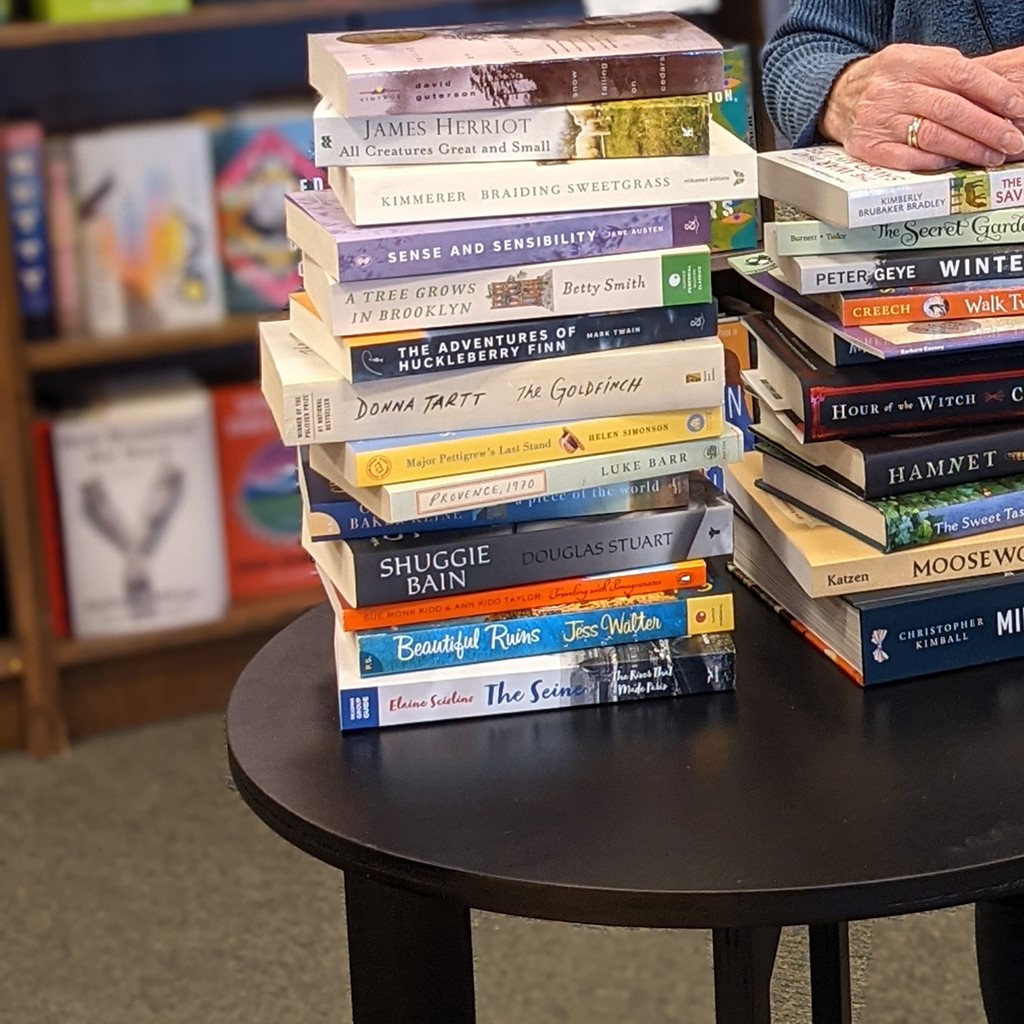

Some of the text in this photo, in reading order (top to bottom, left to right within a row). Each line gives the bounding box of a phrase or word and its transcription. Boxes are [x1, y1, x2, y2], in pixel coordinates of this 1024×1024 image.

[415, 79, 452, 90] david
[571, 69, 579, 98] snow
[601, 62, 609, 97] falling
[630, 79, 638, 95] on
[659, 56, 667, 93] cedars
[416, 91, 477, 103] guterson
[363, 116, 533, 141] JAMES HERRIOT
[339, 139, 551, 158] All Creatures Great and Small
[381, 176, 671, 207] KIMMERER BRAIDING SWEETGRASS
[1001, 177, 1023, 190] THE
[858, 198, 947, 218] BRUBAKER BRADLEY
[880, 191, 924, 207] KIMBERLY
[631, 225, 665, 236] AUSTEN
[826, 232, 847, 242] Tudor
[872, 220, 901, 240] The
[900, 218, 970, 248] Secret
[388, 229, 597, 264] SENSE AND SENSIBILITY
[562, 274, 647, 297] Betty Smith
[816, 264, 917, 287] PETER GEYE
[344, 282, 477, 305] A TREE GROWS
[964, 296, 1008, 316] Walk
[351, 301, 473, 324] IN BROOKLYN
[852, 302, 912, 319] CREECH
[397, 326, 577, 359] THE ADVENTURES OF
[586, 326, 642, 340] MARK TWAIN
[398, 339, 567, 373] HUCKLEBERRY FINN
[516, 376, 644, 407] The GOLDFINCH
[354, 392, 487, 422] DONNA TARTT
[831, 402, 880, 421] HOUR
[883, 400, 894, 414] of
[917, 393, 977, 412] WITCH
[588, 422, 670, 443] HELEN SIMONSON
[406, 438, 552, 471] Major Pettigrew's Last Stand
[600, 451, 688, 478] LUKE BARR
[888, 449, 998, 485] HAMNET
[428, 478, 536, 507] PROVENCE, 1970
[621, 479, 661, 495] world
[933, 520, 960, 536] The
[961, 511, 1002, 530] Sweet
[521, 531, 675, 566] DOUGLAS STUART
[380, 544, 492, 579] SHUGGIE
[406, 569, 467, 596] BAIN
[826, 571, 870, 588] Katzen
[386, 608, 416, 619] MONK
[419, 605, 443, 615] KIDD
[444, 604, 452, 613] &
[454, 601, 476, 611] ANN
[478, 597, 502, 608] KIDD
[504, 592, 542, 604] TAYLOR
[562, 612, 663, 646] Jess Walter
[898, 616, 986, 642] CHRISTOPHER
[915, 631, 970, 651] KIMBALL
[393, 624, 542, 662] Beautiful Ruins
[389, 695, 429, 713] Elaine
[484, 679, 588, 707] The Seine
